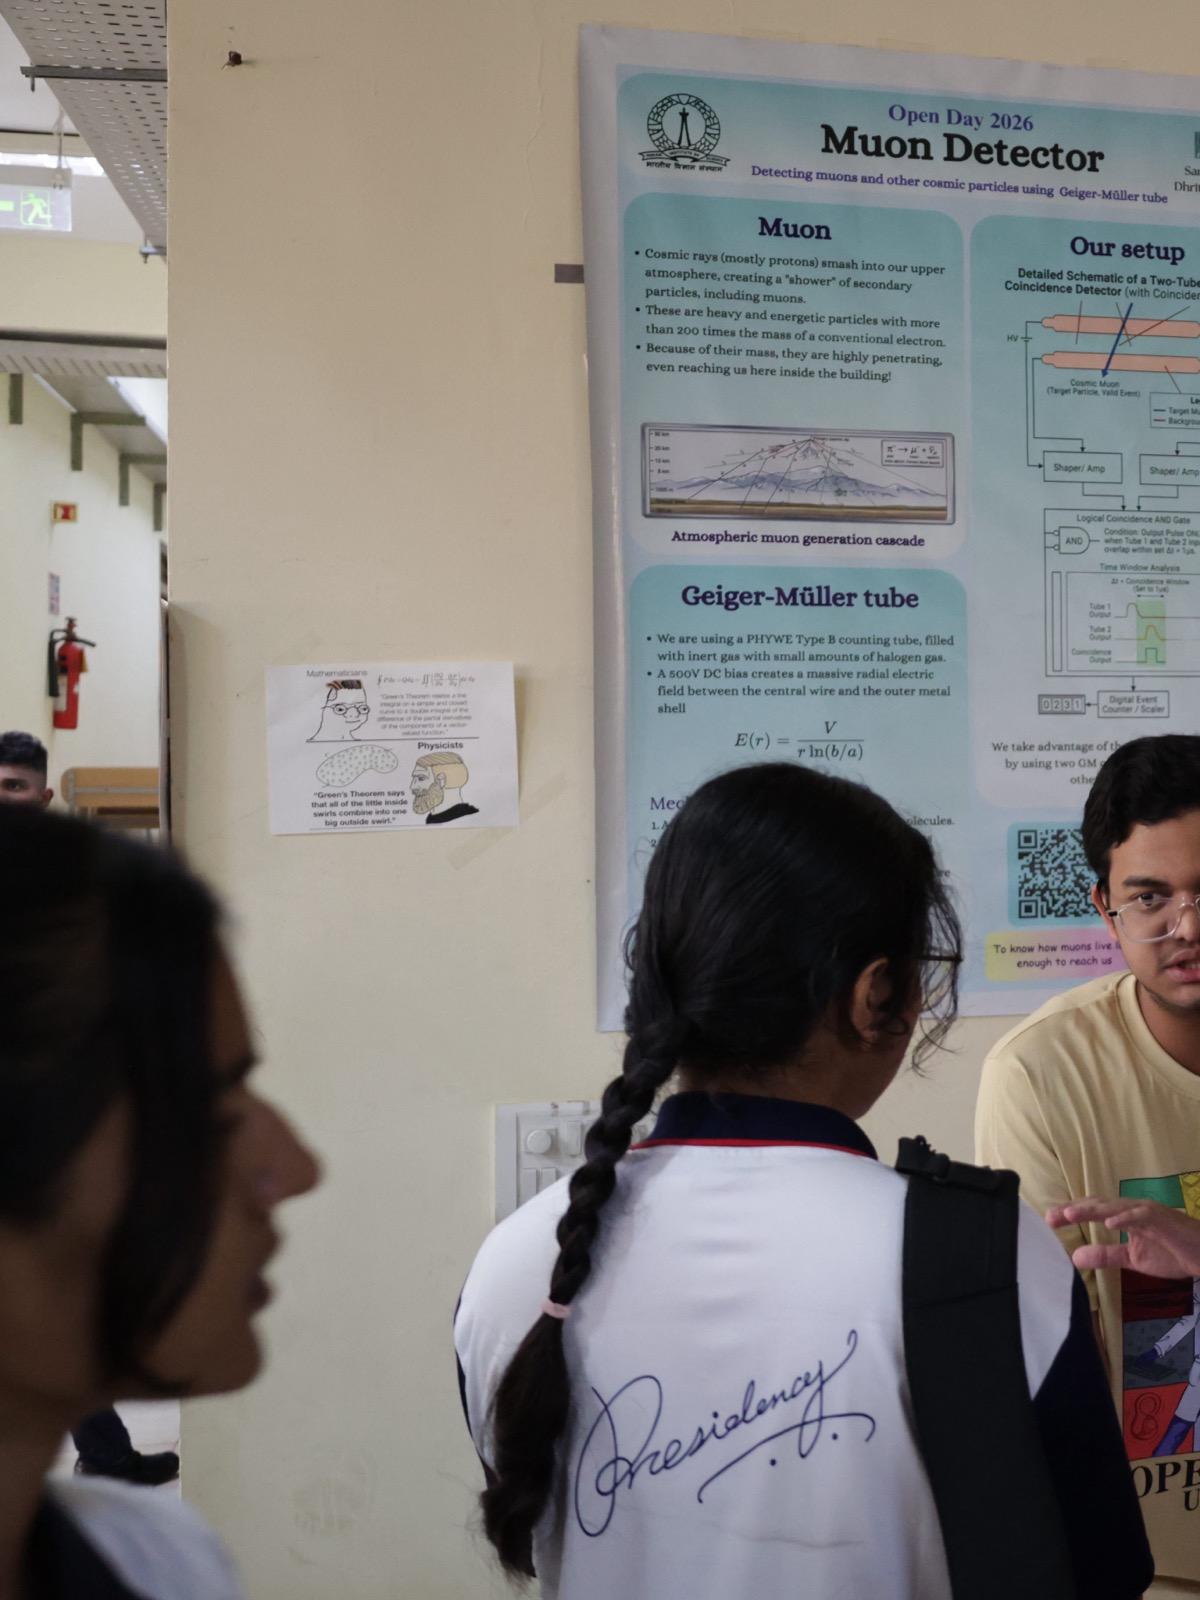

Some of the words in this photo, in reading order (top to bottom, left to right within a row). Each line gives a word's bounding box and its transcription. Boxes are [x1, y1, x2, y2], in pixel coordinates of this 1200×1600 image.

[888, 104, 939, 125] Open
[946, 108, 983, 130] Day
[990, 113, 1033, 130] 2026
[820, 124, 934, 159] Muon
[942, 133, 1104, 171] Detector
[751, 165, 813, 182] Detecting
[815, 172, 858, 182] muons
[860, 173, 884, 184] and
[886, 174, 920, 186] other
[922, 179, 965, 189] cosmic
[968, 181, 1019, 192] particles
[1021, 184, 1054, 198] using
[1059, 187, 1139, 201] Geiger-Müller
[1142, 192, 1167, 203] tube
[758, 217, 832, 239] Muon
[1070, 236, 1116, 256] Our
[1121, 243, 1185, 265] setup
[644, 248, 689, 260] Cosmic
[692, 253, 718, 263] rays
[720, 252, 765, 266] (mostly
[768, 257, 818, 268] protons)
[821, 259, 858, 269] smash
[861, 260, 884, 271] into
[887, 264, 908, 272] our
[910, 266, 945, 276] upper
[644, 268, 720, 281] atmosphere,
[723, 273, 773, 286] creating
[775, 276, 782, 284] a
[838, 277, 851, 287] of
[853, 280, 912, 292] secondary
[1018, 268, 1063, 280] Detailed
[1066, 270, 1124, 283] Schematic
[1126, 274, 1137, 284] of
[1140, 276, 1146, 284] a
[645, 287, 700, 298] particles,
[704, 288, 760, 303] including
[762, 294, 806, 303] muons.
[1004, 280, 1072, 293] Coincidence
[1075, 284, 1122, 296] Detector
[1124, 286, 1150, 297] (with
[644, 304, 680, 316] These
[684, 308, 703, 316] are
[706, 306, 742, 320] heavy
[744, 310, 767, 320] and
[770, 313, 825, 324] energetic
[828, 314, 878, 325] particles
[880, 316, 907, 326] with
[910, 320, 940, 328] more
[646, 342, 695, 353] Because
[698, 344, 712, 354] of
[713, 344, 742, 356] their
[745, 349, 778, 358] mass,
[781, 348, 808, 361] they
[810, 352, 829, 360] are
[832, 350, 869, 364] highly
[872, 354, 942, 367] penetrating,
[646, 363, 674, 372] even
[678, 362, 730, 376] reaching
[733, 367, 747, 375] us
[750, 364, 776, 376] here
[779, 366, 815, 377] inside
[818, 368, 837, 378] the
[839, 369, 891, 383] building!
[1076, 514, 1104, 523] Logical
[1106, 514, 1153, 523] Coincidence
[1154, 515, 1171, 524] AND
[1172, 516, 1190, 524] Gate
[671, 531, 758, 544] Atmospheric
[760, 534, 799, 543] muon
[802, 534, 872, 546] generation
[875, 535, 924, 546] cascade
[681, 585, 858, 610] Geiger-Müller
[863, 587, 918, 607] tube
[656, 633, 675, 643] We
[678, 635, 697, 644] are
[700, 634, 734, 646] using
[736, 636, 743, 644] a
[746, 634, 792, 644] PHYWE
[795, 634, 824, 646] Type
[828, 634, 836, 644] B
[838, 635, 890, 647] counting
[892, 634, 922, 646] tube,
[924, 634, 954, 645] filled
[656, 668, 666, 680] A
[669, 668, 700, 678] 500V
[703, 668, 721, 678] DC
[724, 668, 748, 678] bias
[751, 670, 794, 678] creates
[796, 670, 803, 678] a
[806, 668, 853, 678] massive
[856, 668, 889, 679] radial
[892, 669, 934, 679] electric
[1109, 695, 1134, 705] Digital
[1136, 695, 1157, 705] Event
[417, 742, 463, 750] Physicists
[991, 742, 1008, 751] We
[1011, 741, 1035, 751] take
[1037, 742, 1093, 753] advantage
[1096, 740, 1108, 751] of
[1016, 957, 1052, 969] enough
[1055, 958, 1066, 966] to
[1069, 956, 1098, 965] reach
[1100, 957, 1112, 965] us
[574, 1328, 866, 1538] Presidency
